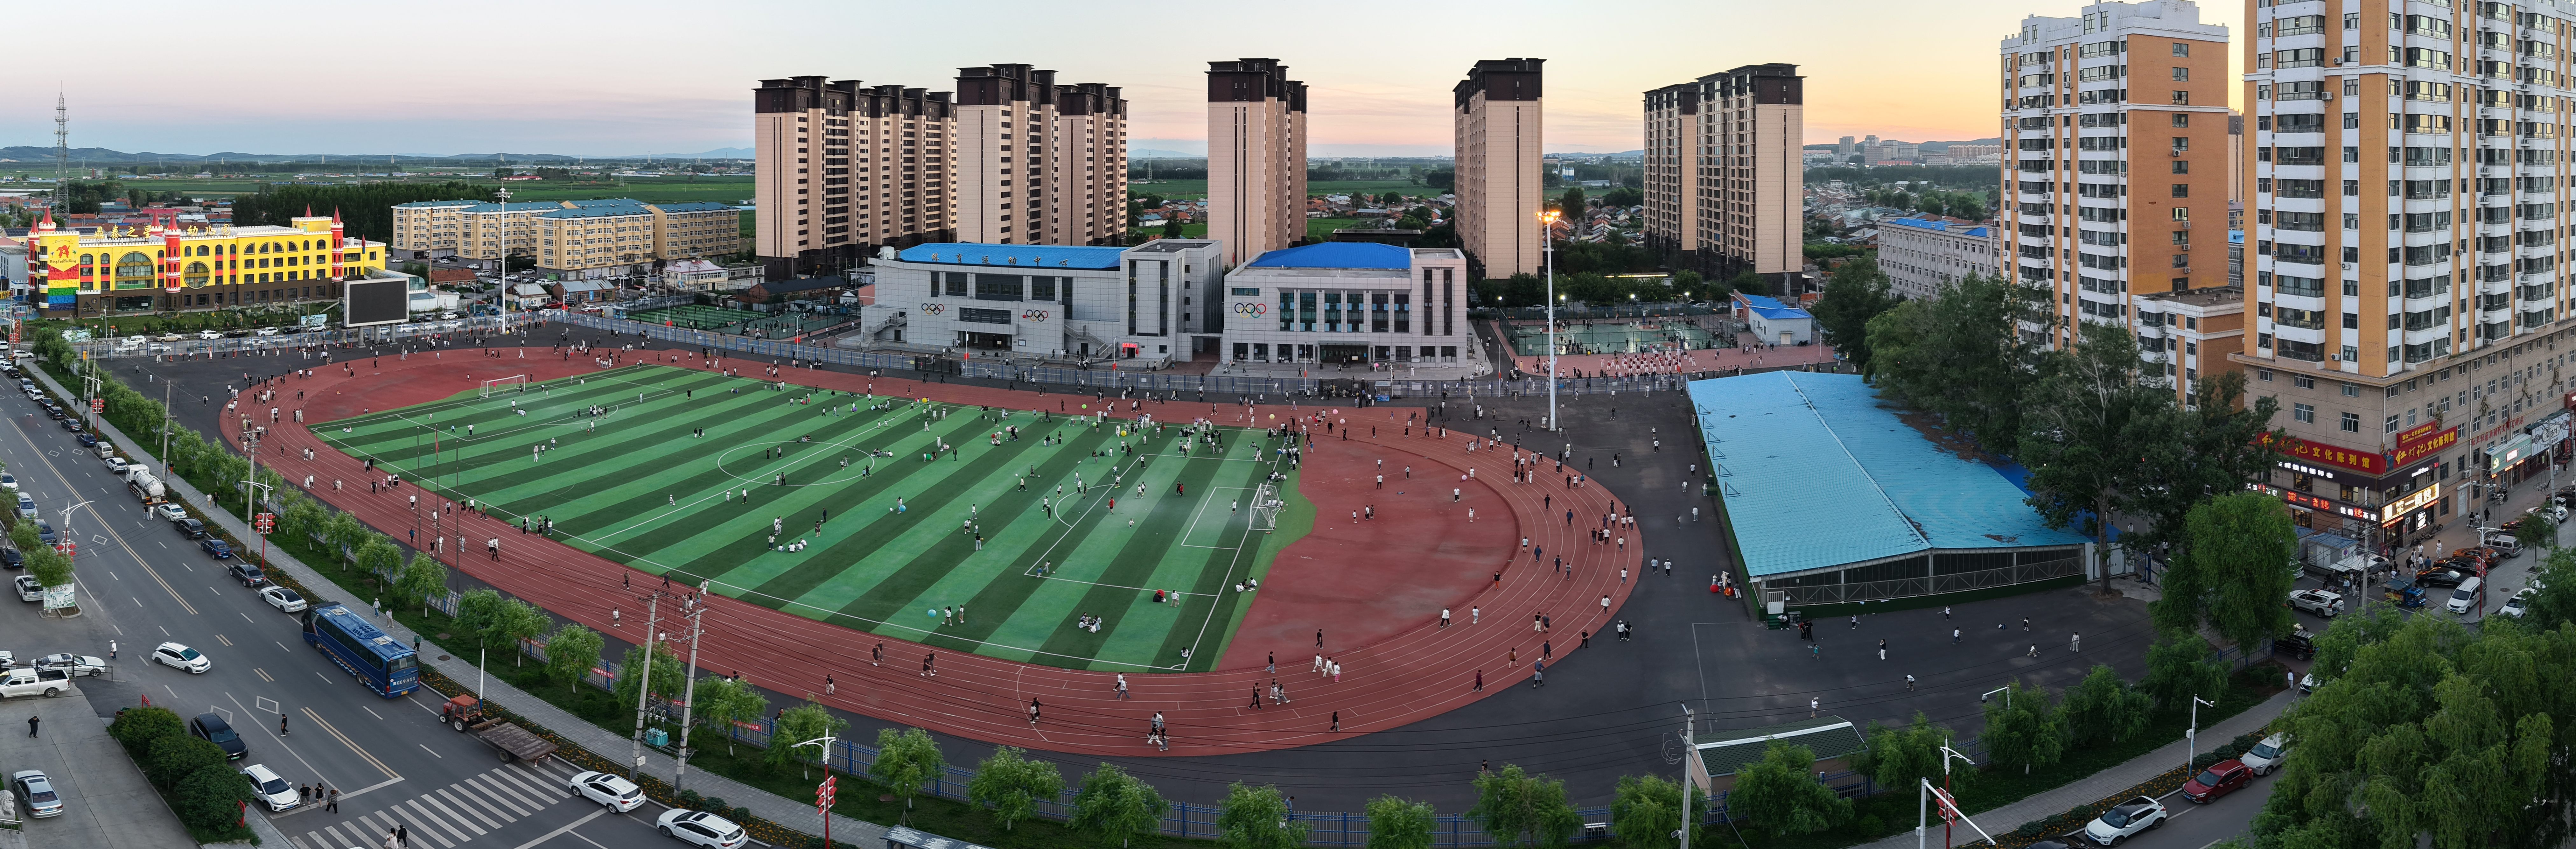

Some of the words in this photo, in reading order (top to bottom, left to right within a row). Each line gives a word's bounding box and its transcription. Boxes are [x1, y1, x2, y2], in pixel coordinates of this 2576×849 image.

[187, 223, 231, 236] 幼儿园
[931, 252, 1069, 267] 体育运动中心
[2396, 432, 2454, 465] 红灯记文化陈列馆
